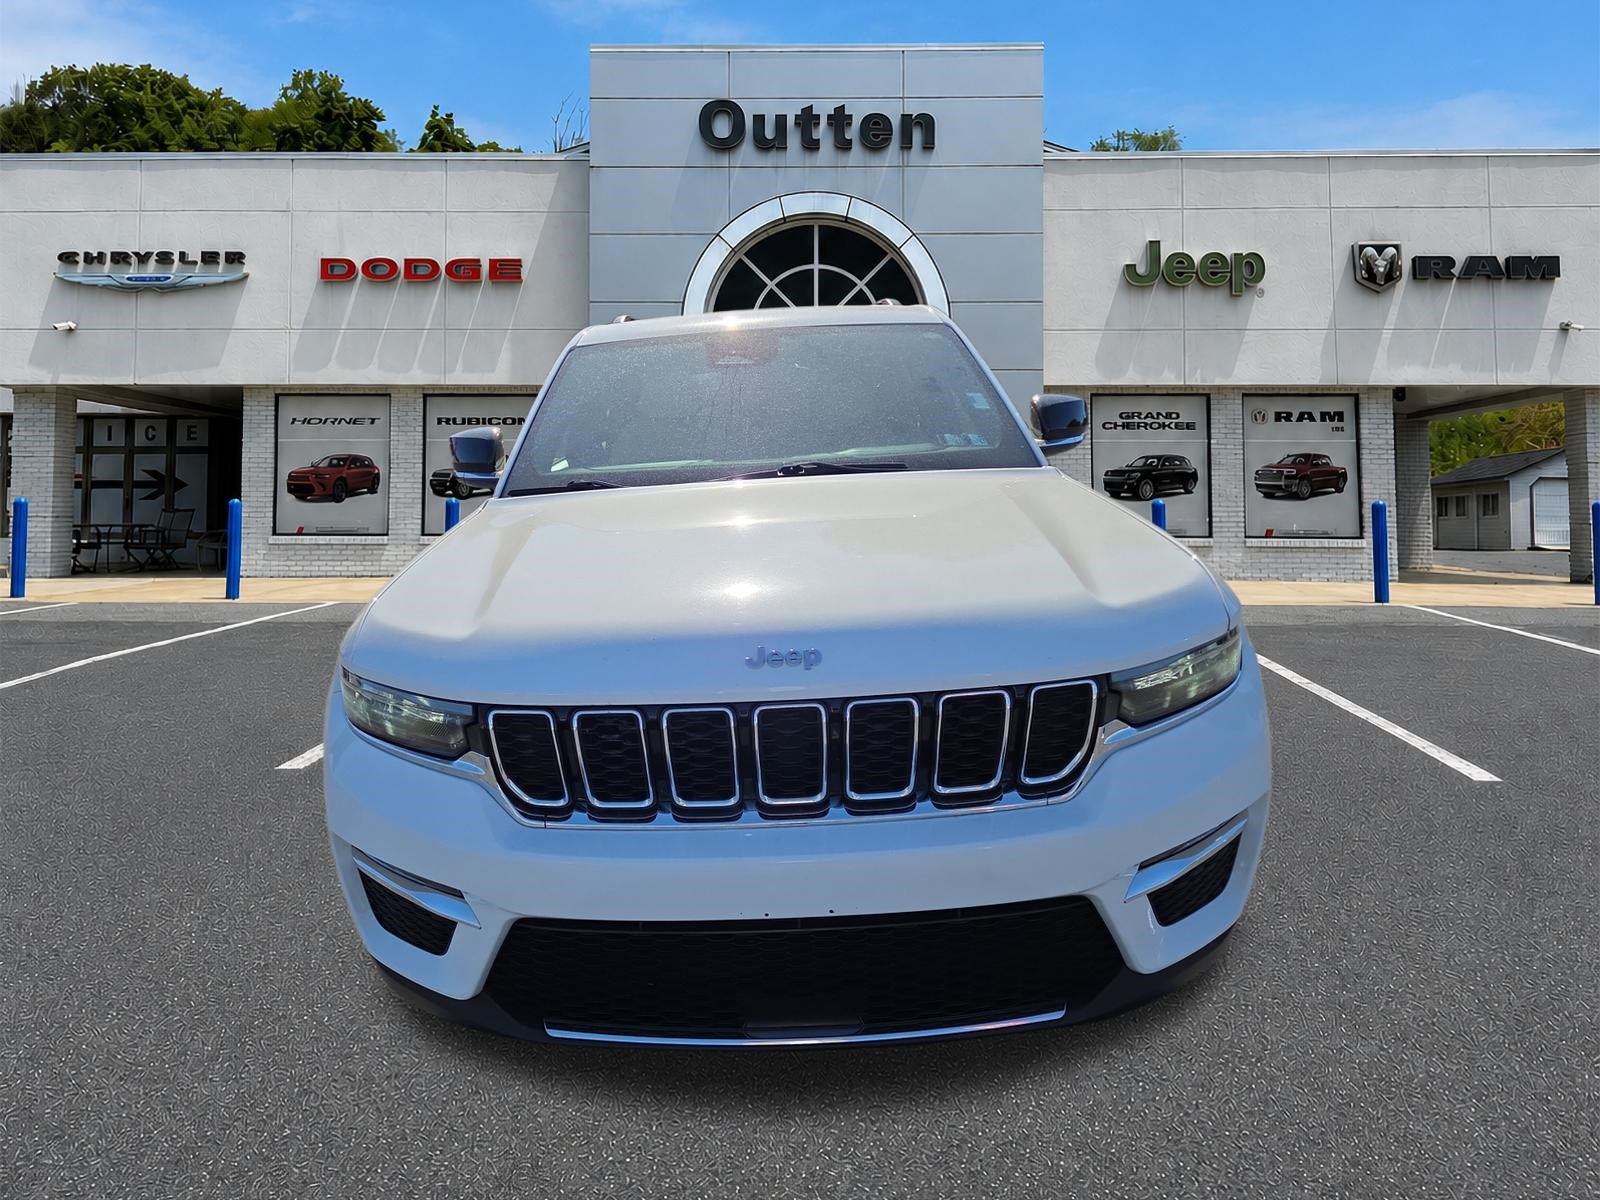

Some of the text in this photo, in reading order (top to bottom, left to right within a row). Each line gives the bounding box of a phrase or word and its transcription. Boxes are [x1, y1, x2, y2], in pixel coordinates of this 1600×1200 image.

[699, 99, 936, 150] Outten
[57, 250, 247, 265] CHRYSLER
[1411, 255, 1560, 280] RAM
[320, 257, 523, 282] DODGE
[1123, 239, 1266, 297] Jeep
[290, 417, 381, 425] HORNET
[1118, 411, 1181, 420] GRAND
[1274, 411, 1344, 422] RAM
[1101, 421, 1196, 431] CHEROKEE
[745, 646, 823, 671] Jeep
